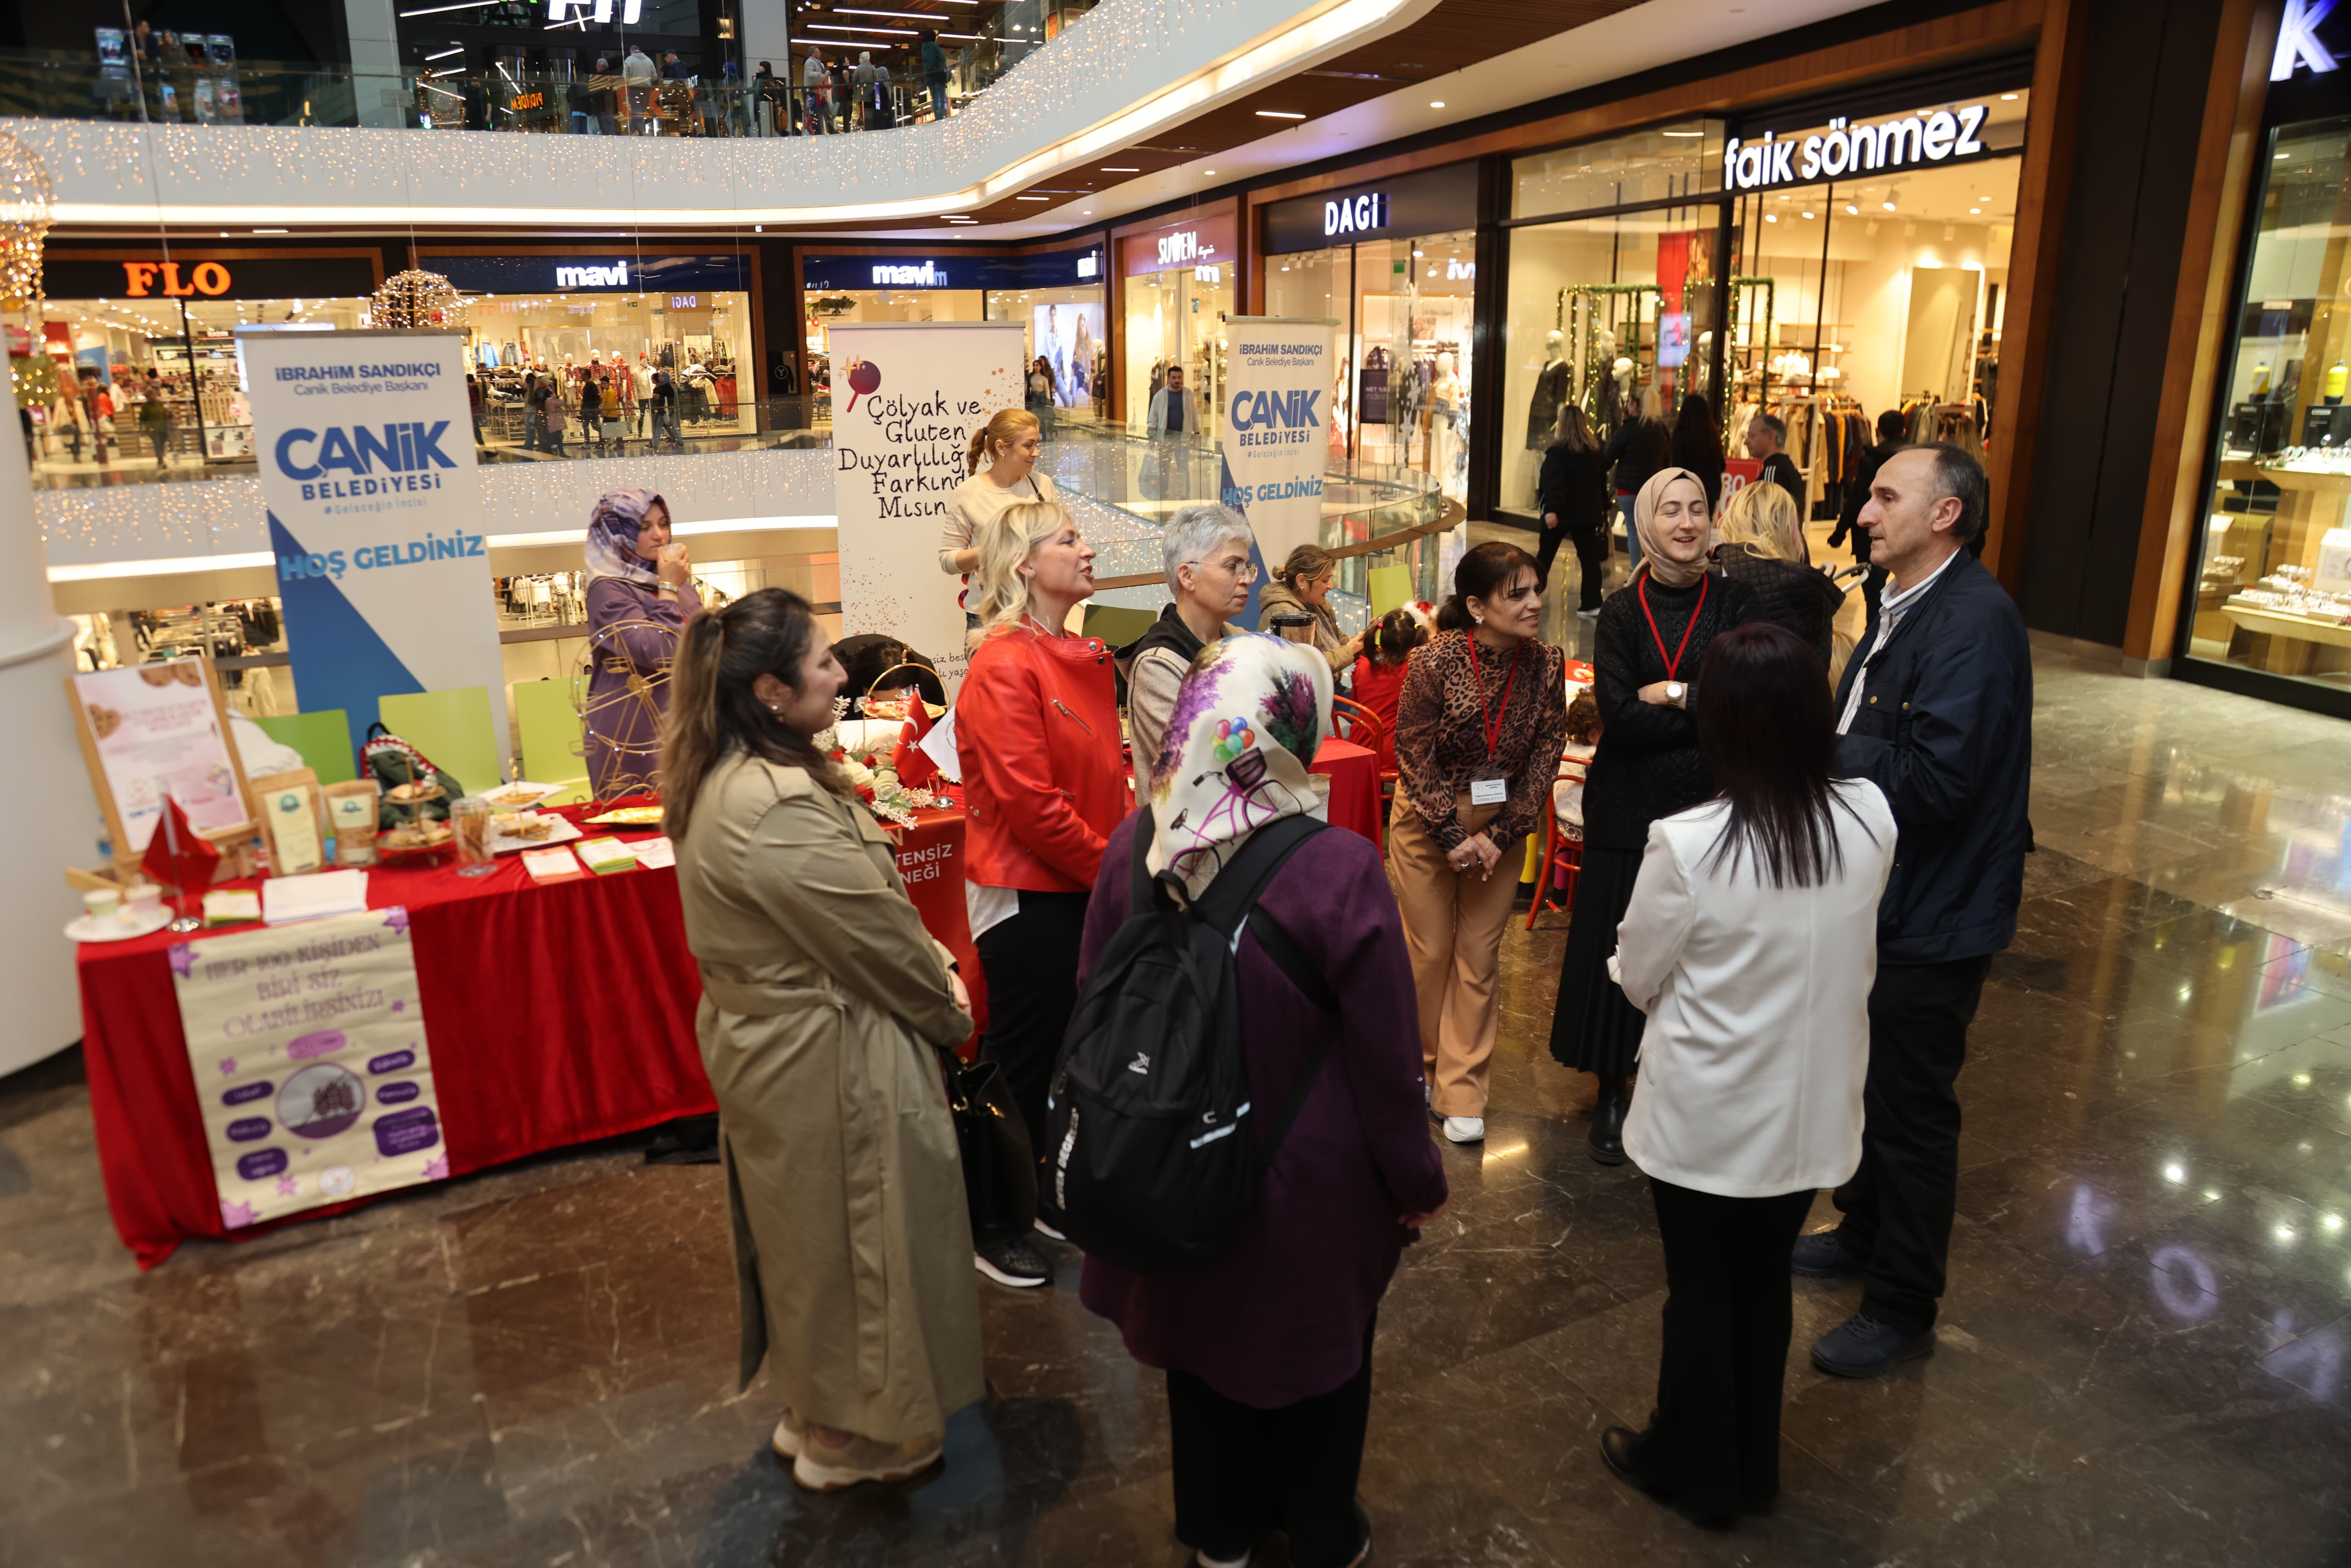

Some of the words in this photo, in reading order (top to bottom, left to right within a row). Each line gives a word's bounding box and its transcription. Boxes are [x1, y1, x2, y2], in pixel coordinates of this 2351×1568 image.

[1724, 130, 1796, 190] faik
[1801, 105, 1987, 180] sönmez
[1158, 231, 1197, 265] SUWEN
[123, 262, 231, 296] FLO
[556, 261, 628, 287] mavi
[872, 260, 934, 284] mavi
[1247, 357, 1264, 366] Canik
[1265, 357, 1291, 367] Belediye
[1293, 357, 1314, 367] Başkanı
[1280, 344, 1322, 356] SANDIKÇI
[360, 363, 441, 378] SANDIKÇI
[294, 383, 329, 396] Canik
[332, 382, 382, 395] Belediye
[385, 380, 428, 393] Başkanı
[867, 390, 948, 425] Çölyak
[957, 399, 981, 415] ve
[886, 420, 967, 444] Gluten
[838, 444, 970, 474] Duyarlılığ
[1247, 450, 1283, 458] #Geleceğin
[872, 465, 966, 495] Farkınd
[1222, 485, 1253, 508] HOŞ
[1257, 474, 1322, 502] GELDİNİZ
[280, 551, 347, 581] HOŞ
[354, 529, 485, 570] GELDİNİZ
[929, 654, 946, 664] siz
[895, 843, 952, 867] TENSİZ
[900, 862, 940, 884] NEĞİ
